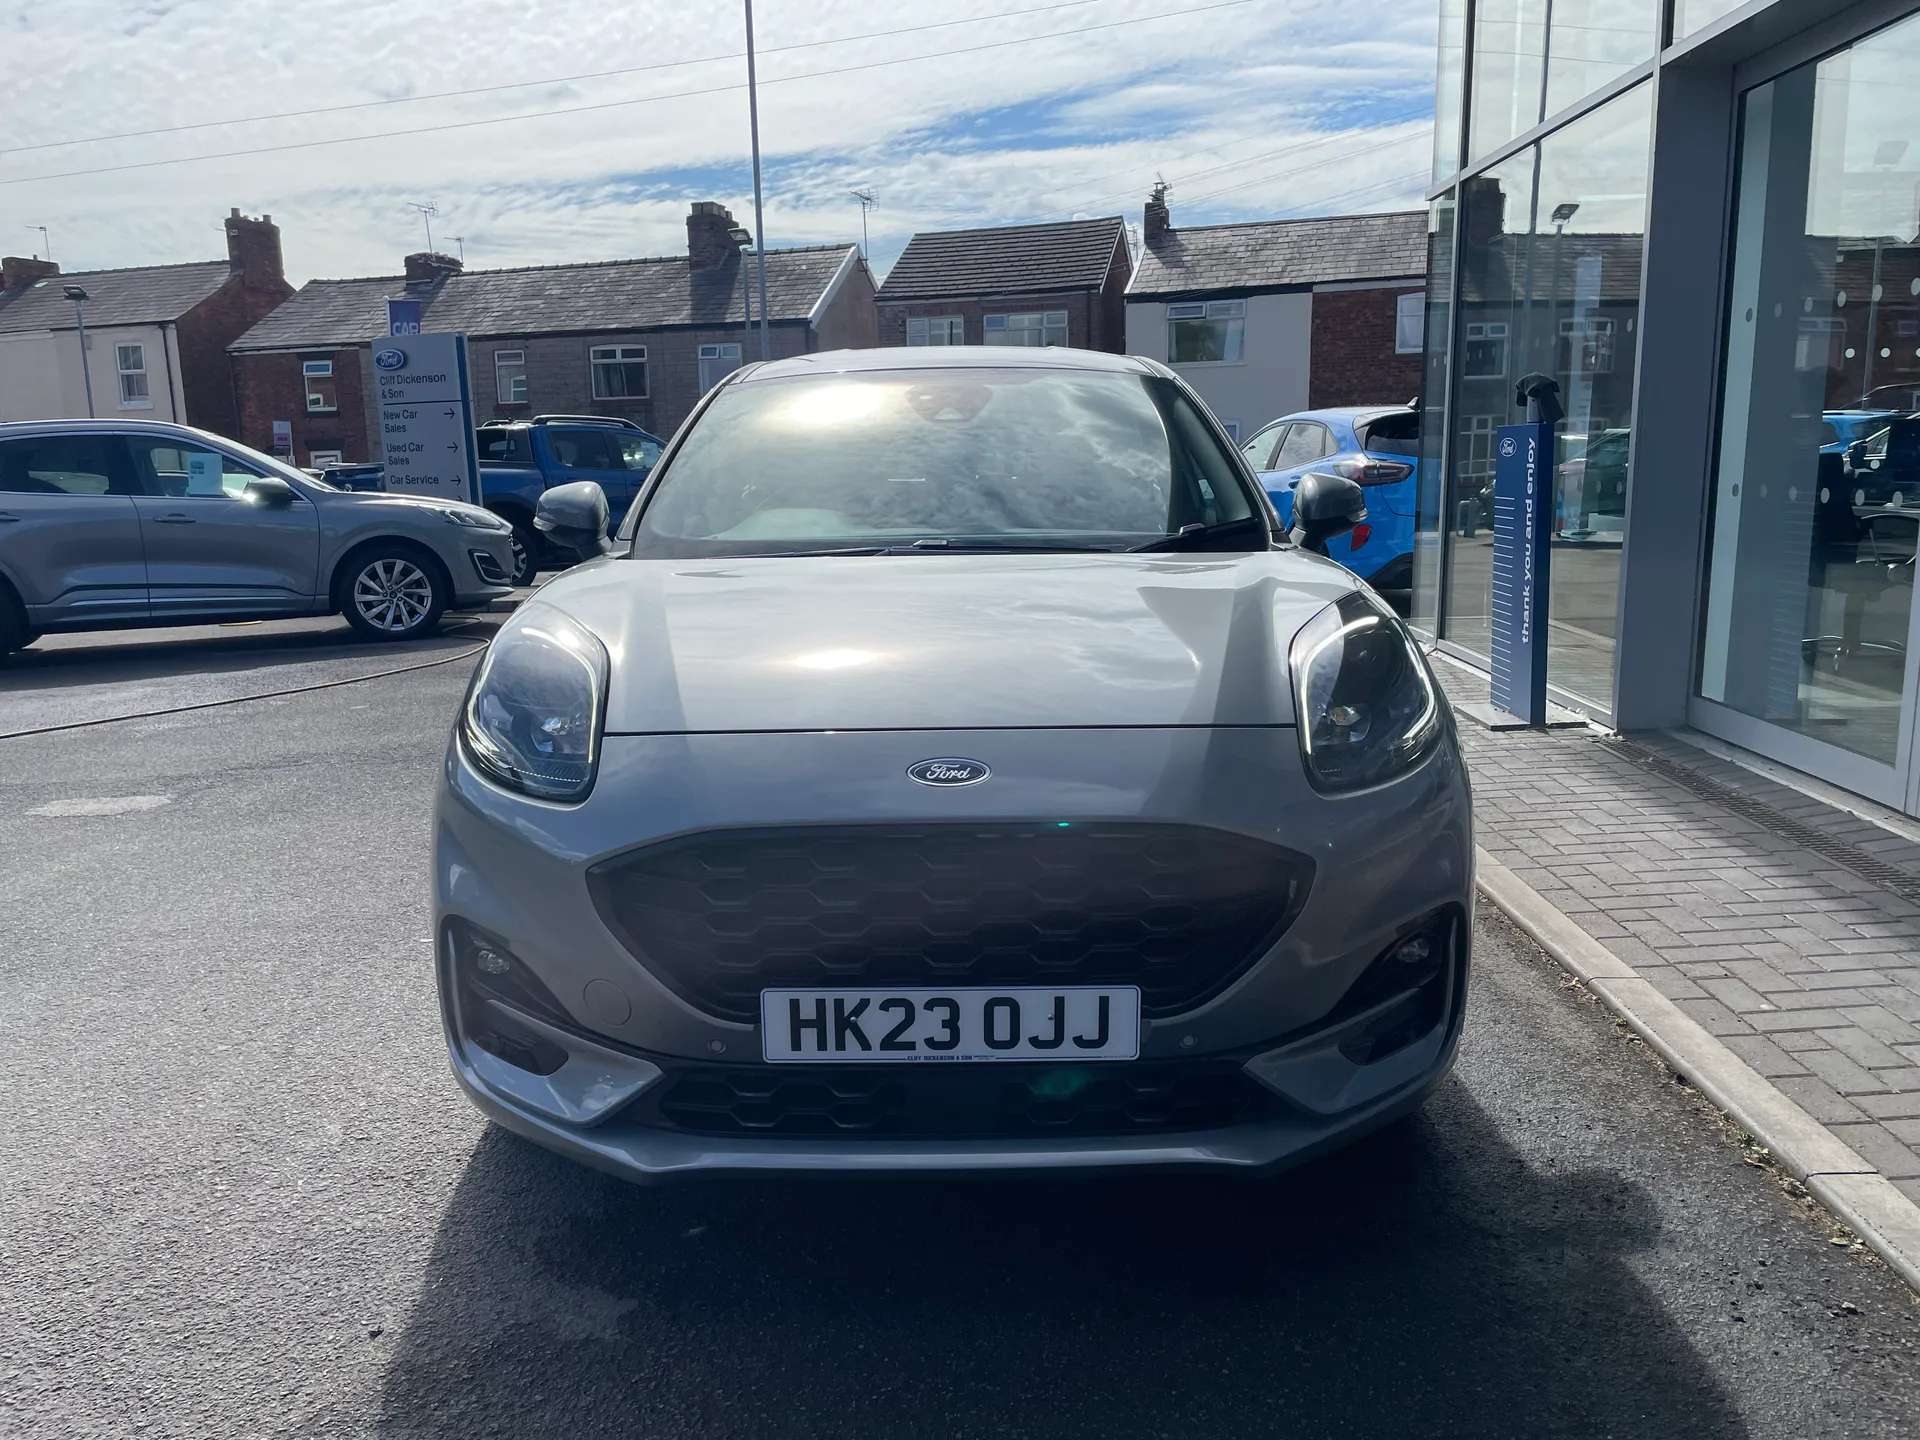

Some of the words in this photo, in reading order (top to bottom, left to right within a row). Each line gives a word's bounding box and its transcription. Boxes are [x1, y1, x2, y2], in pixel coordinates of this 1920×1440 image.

[380, 375, 395, 386] Cliff
[396, 374, 447, 385] Dickenson
[381, 389, 387, 399] &
[388, 389, 405, 399] Son
[383, 410, 400, 420] New
[402, 409, 418, 419] Car
[384, 424, 407, 433] Sales
[386, 443, 407, 453] Used
[408, 442, 424, 452] Car
[388, 456, 410, 466] Sales
[1526, 437, 1536, 495] enjoy
[390, 475, 404, 485] Car
[405, 474, 439, 485] Service
[1525, 499, 1533, 539] and
[1524, 543, 1532, 581] you
[1521, 585, 1530, 643] thank
[789, 997, 960, 1052] HK23
[983, 996, 1110, 1050] OJJ
